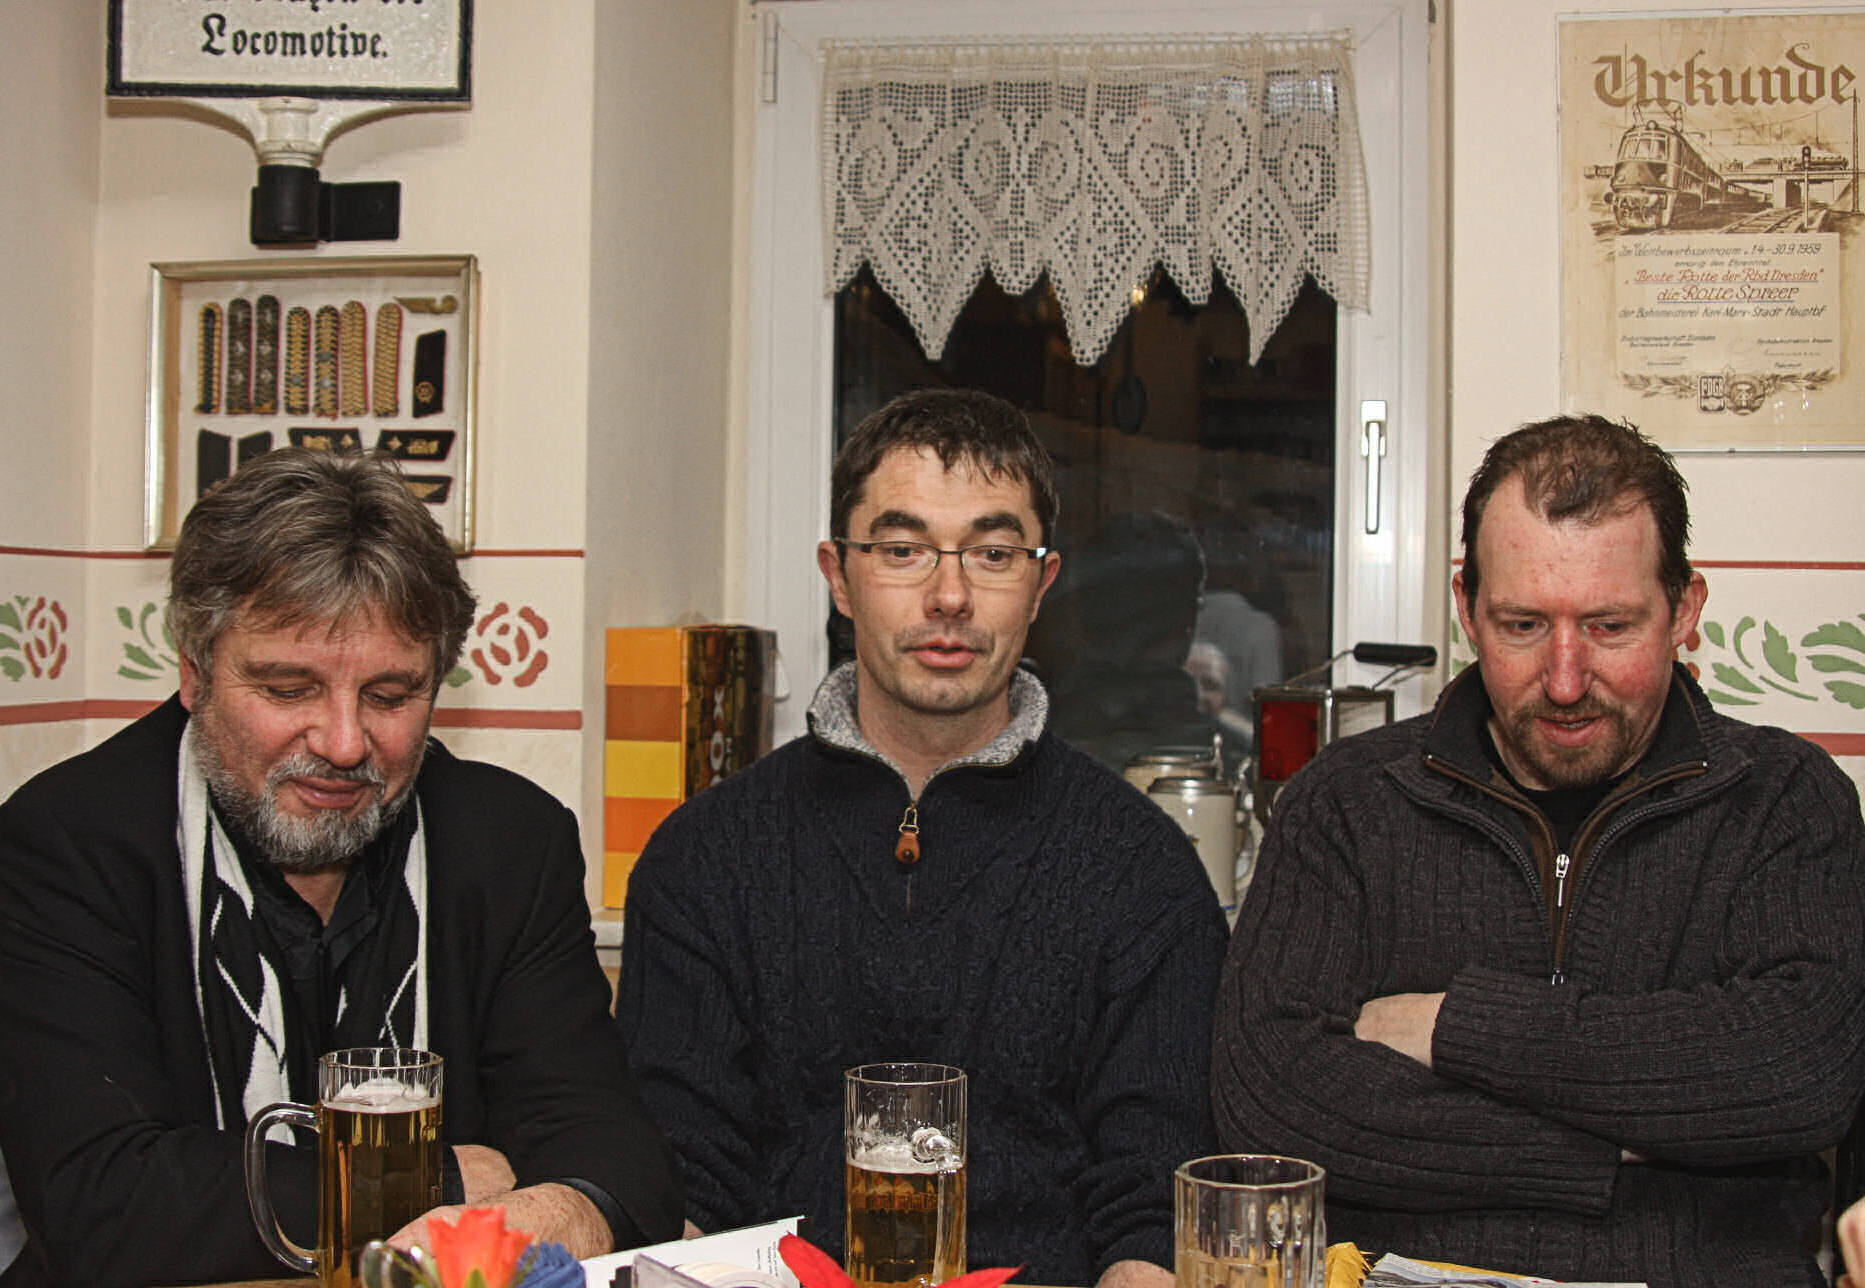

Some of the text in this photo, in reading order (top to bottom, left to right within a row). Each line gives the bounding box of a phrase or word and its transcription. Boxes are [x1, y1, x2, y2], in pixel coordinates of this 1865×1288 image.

[201, 13, 388, 58] Locomotive.
[1592, 43, 1856, 107] Urkunde
[1721, 269, 1741, 281] der
[1657, 288, 1680, 300] die
